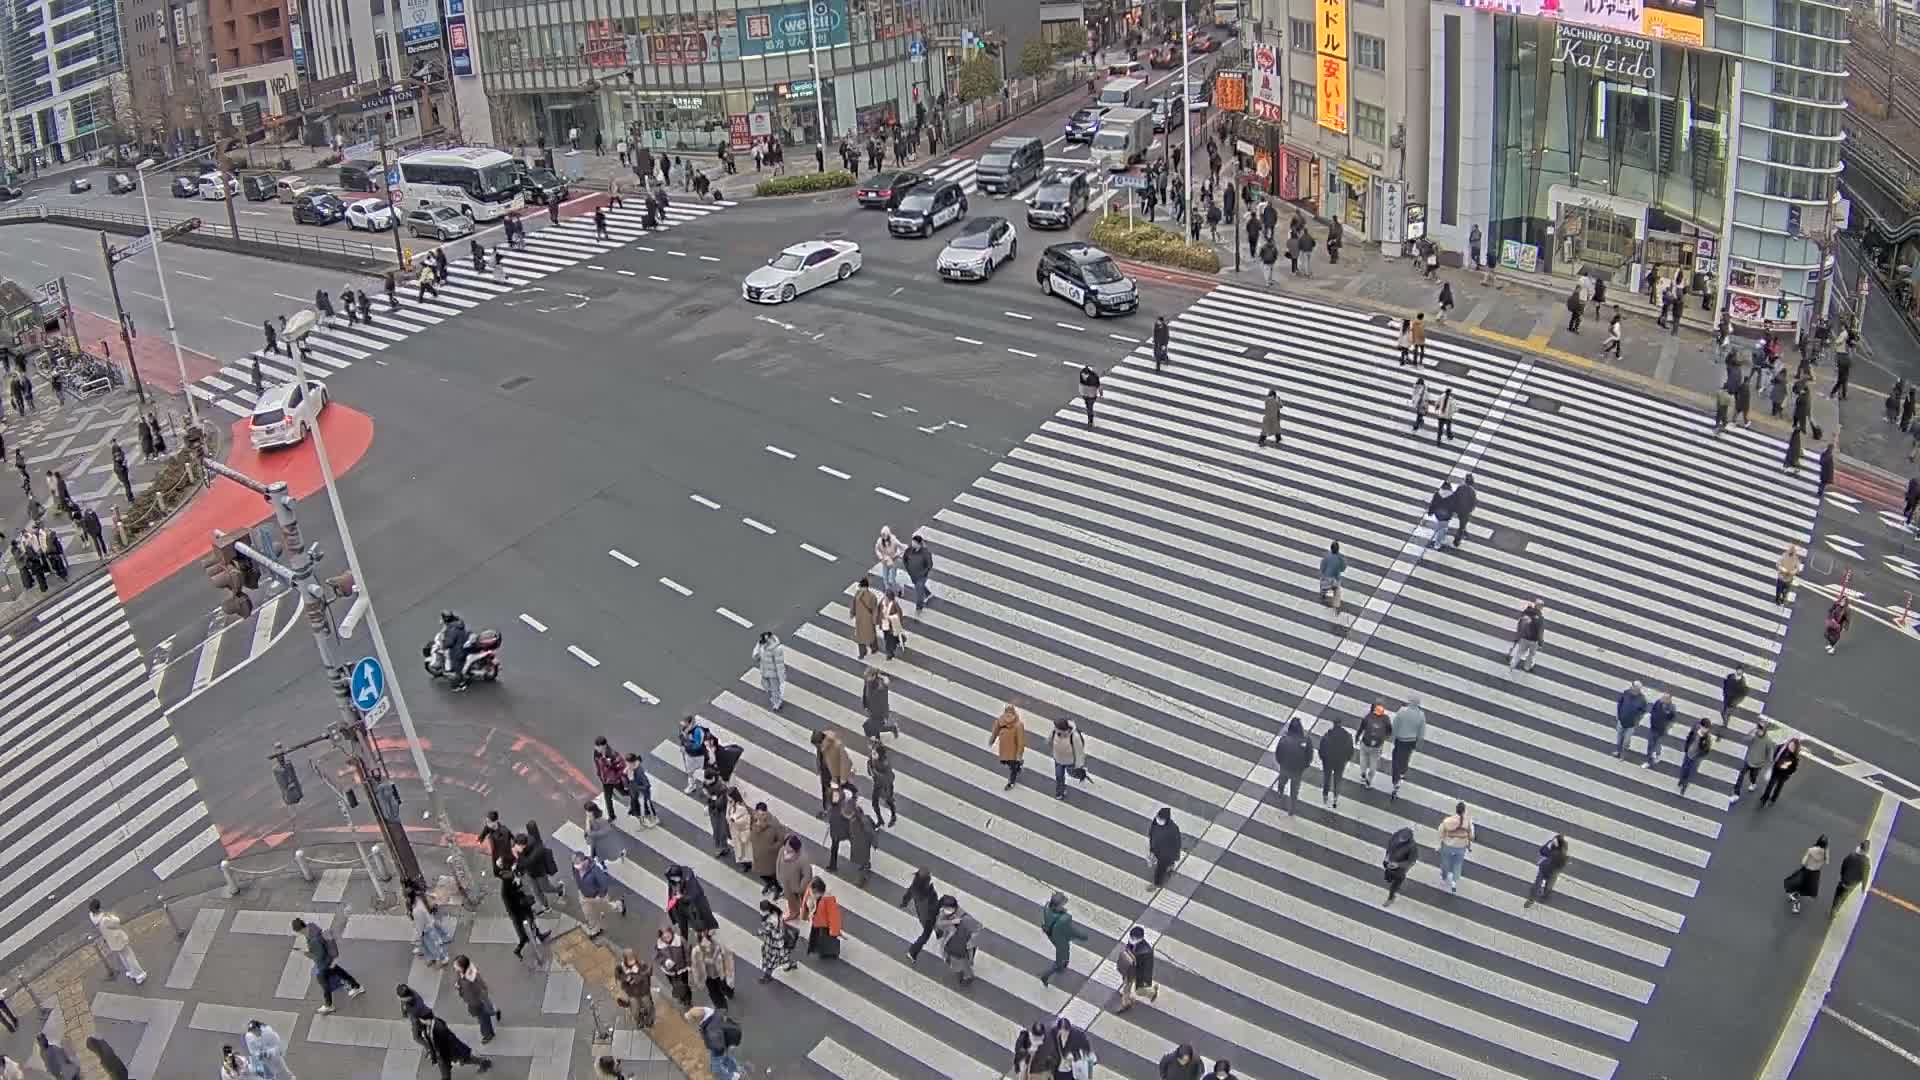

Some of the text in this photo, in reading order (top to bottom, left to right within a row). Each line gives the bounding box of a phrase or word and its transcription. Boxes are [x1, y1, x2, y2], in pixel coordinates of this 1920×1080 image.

[1556, 24, 1613, 45] PACHINKO
[1624, 37, 1651, 51] SLOT
[1550, 38, 1656, 79] Kaleido
[362, 90, 413, 110] BIGVIION
